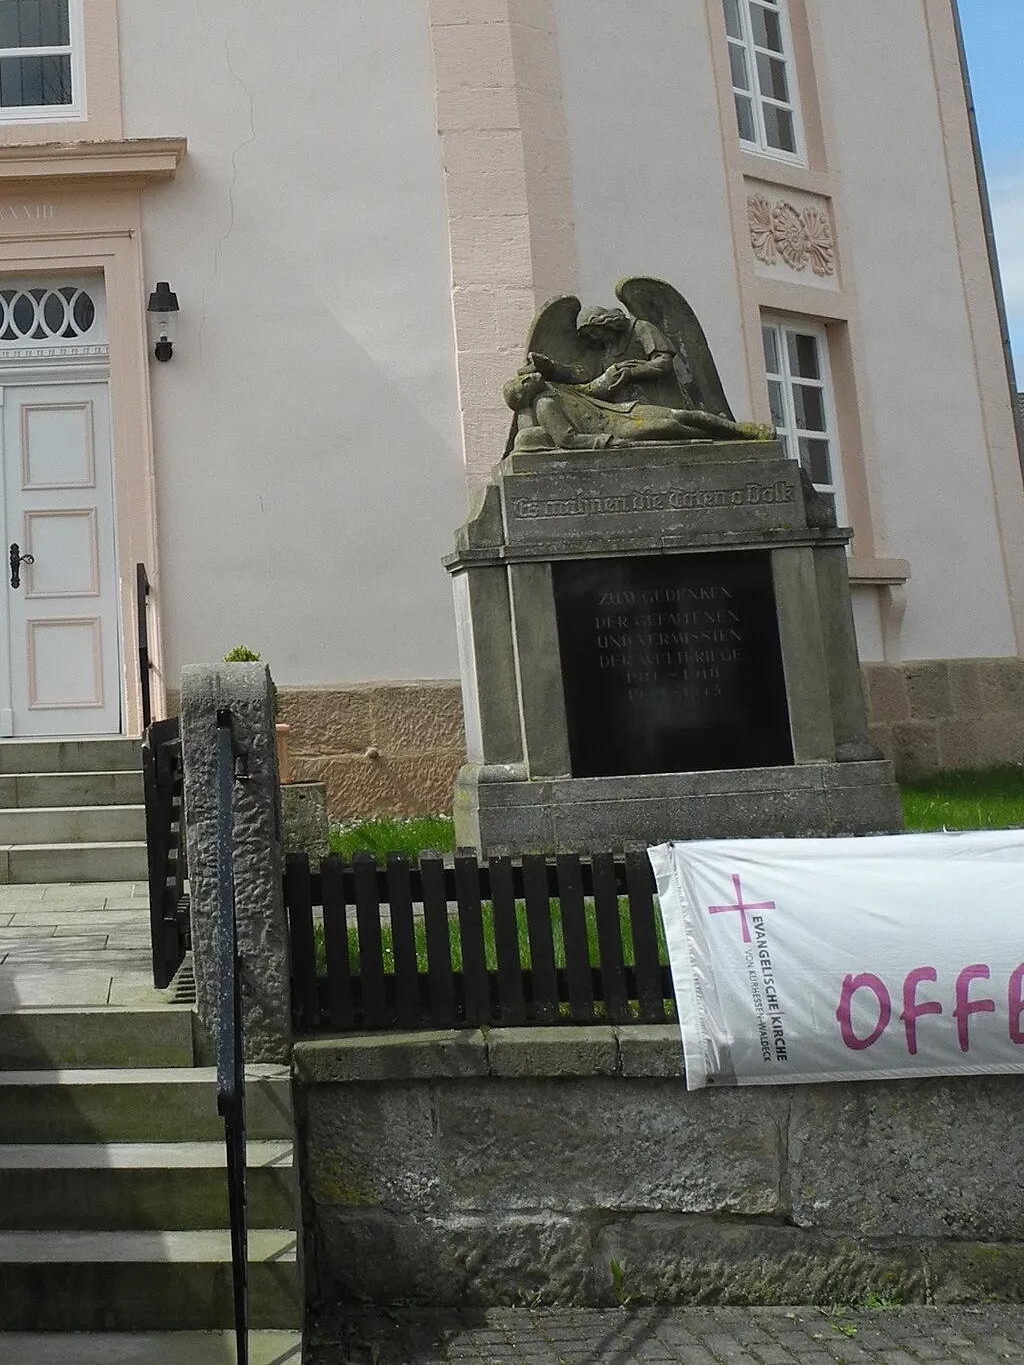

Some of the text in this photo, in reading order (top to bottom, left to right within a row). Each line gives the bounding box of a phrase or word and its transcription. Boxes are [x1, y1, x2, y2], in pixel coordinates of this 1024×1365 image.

[513, 497, 537, 518] Es
[543, 493, 628, 520] mahnen
[632, 490, 663, 512] die
[668, 488, 725, 509] Toten
[745, 482, 795, 504] Volk
[598, 586, 732, 605] ZUM GEDENKEN
[595, 610, 740, 629] DER GEFALLENEN
[597, 629, 742, 648] UND VERMISSTEN
[599, 648, 743, 667] DER WELTKRIEGE
[744, 949, 772, 1063] VON KURHESSEN-WALDECK
